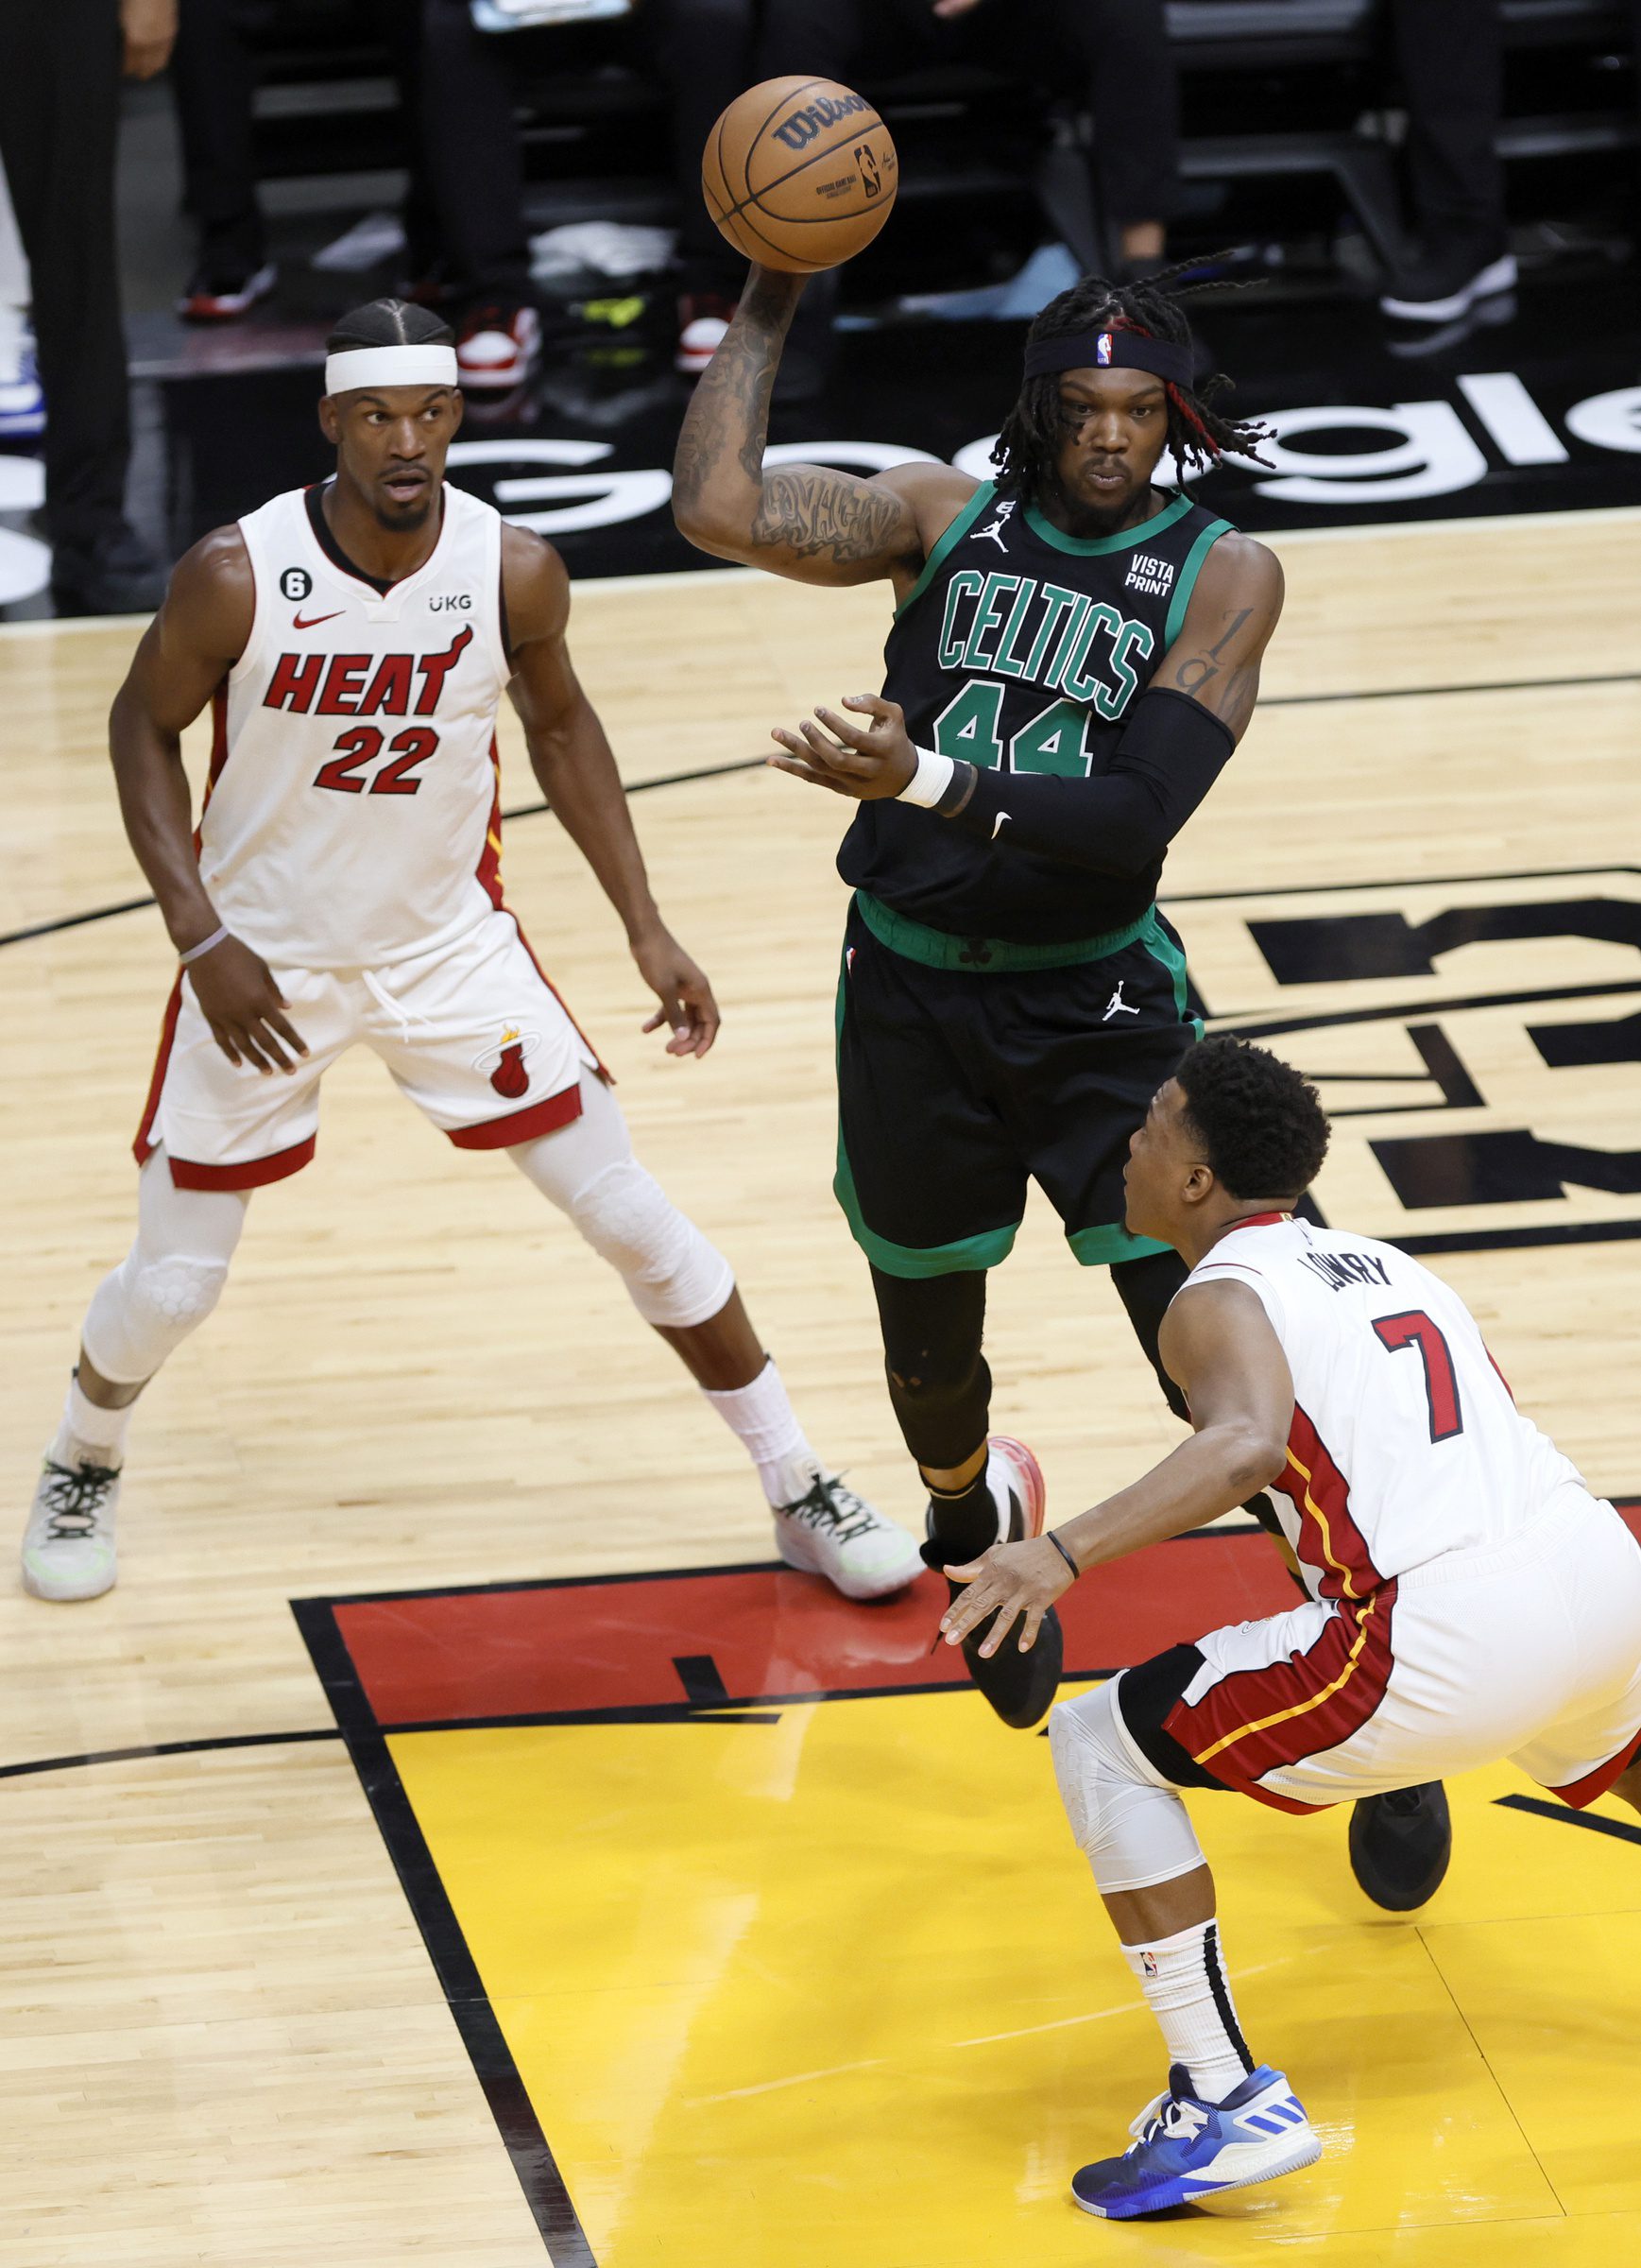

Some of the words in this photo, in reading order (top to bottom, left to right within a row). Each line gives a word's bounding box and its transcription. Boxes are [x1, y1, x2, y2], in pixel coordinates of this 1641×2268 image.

[996, 501, 1017, 514] 6
[285, 572, 305, 593] 6
[1124, 572, 1171, 596] PRINT
[1130, 554, 1174, 583] VISTA
[262, 623, 473, 716] HEAT
[938, 570, 1154, 721] CELTICS
[932, 679, 1093, 777] 44
[313, 726, 440, 795] 22
[1297, 1252, 1393, 1292] LOWRY
[1371, 1310, 1463, 1444] 7
